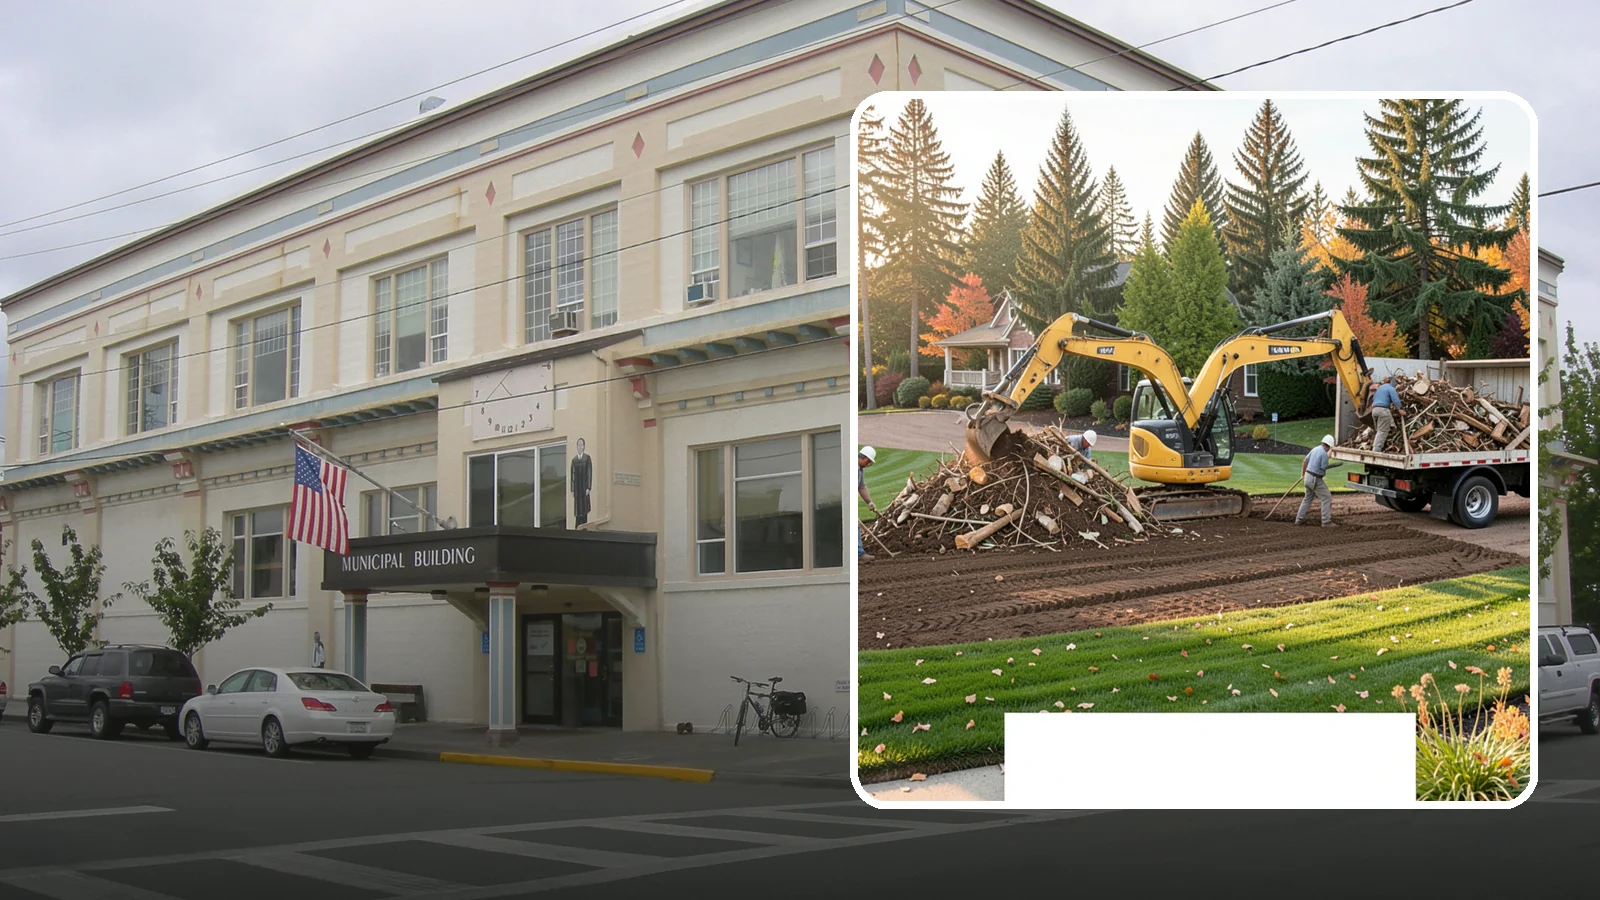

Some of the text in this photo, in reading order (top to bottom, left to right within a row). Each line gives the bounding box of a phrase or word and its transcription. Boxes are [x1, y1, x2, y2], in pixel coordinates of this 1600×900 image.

[480, 406, 485, 415] 8
[487, 417, 493, 426] 9
[494, 423, 500, 432] 10
[507, 425, 513, 433] 12
[341, 546, 475, 572] MUNICIPAL BUILDING
